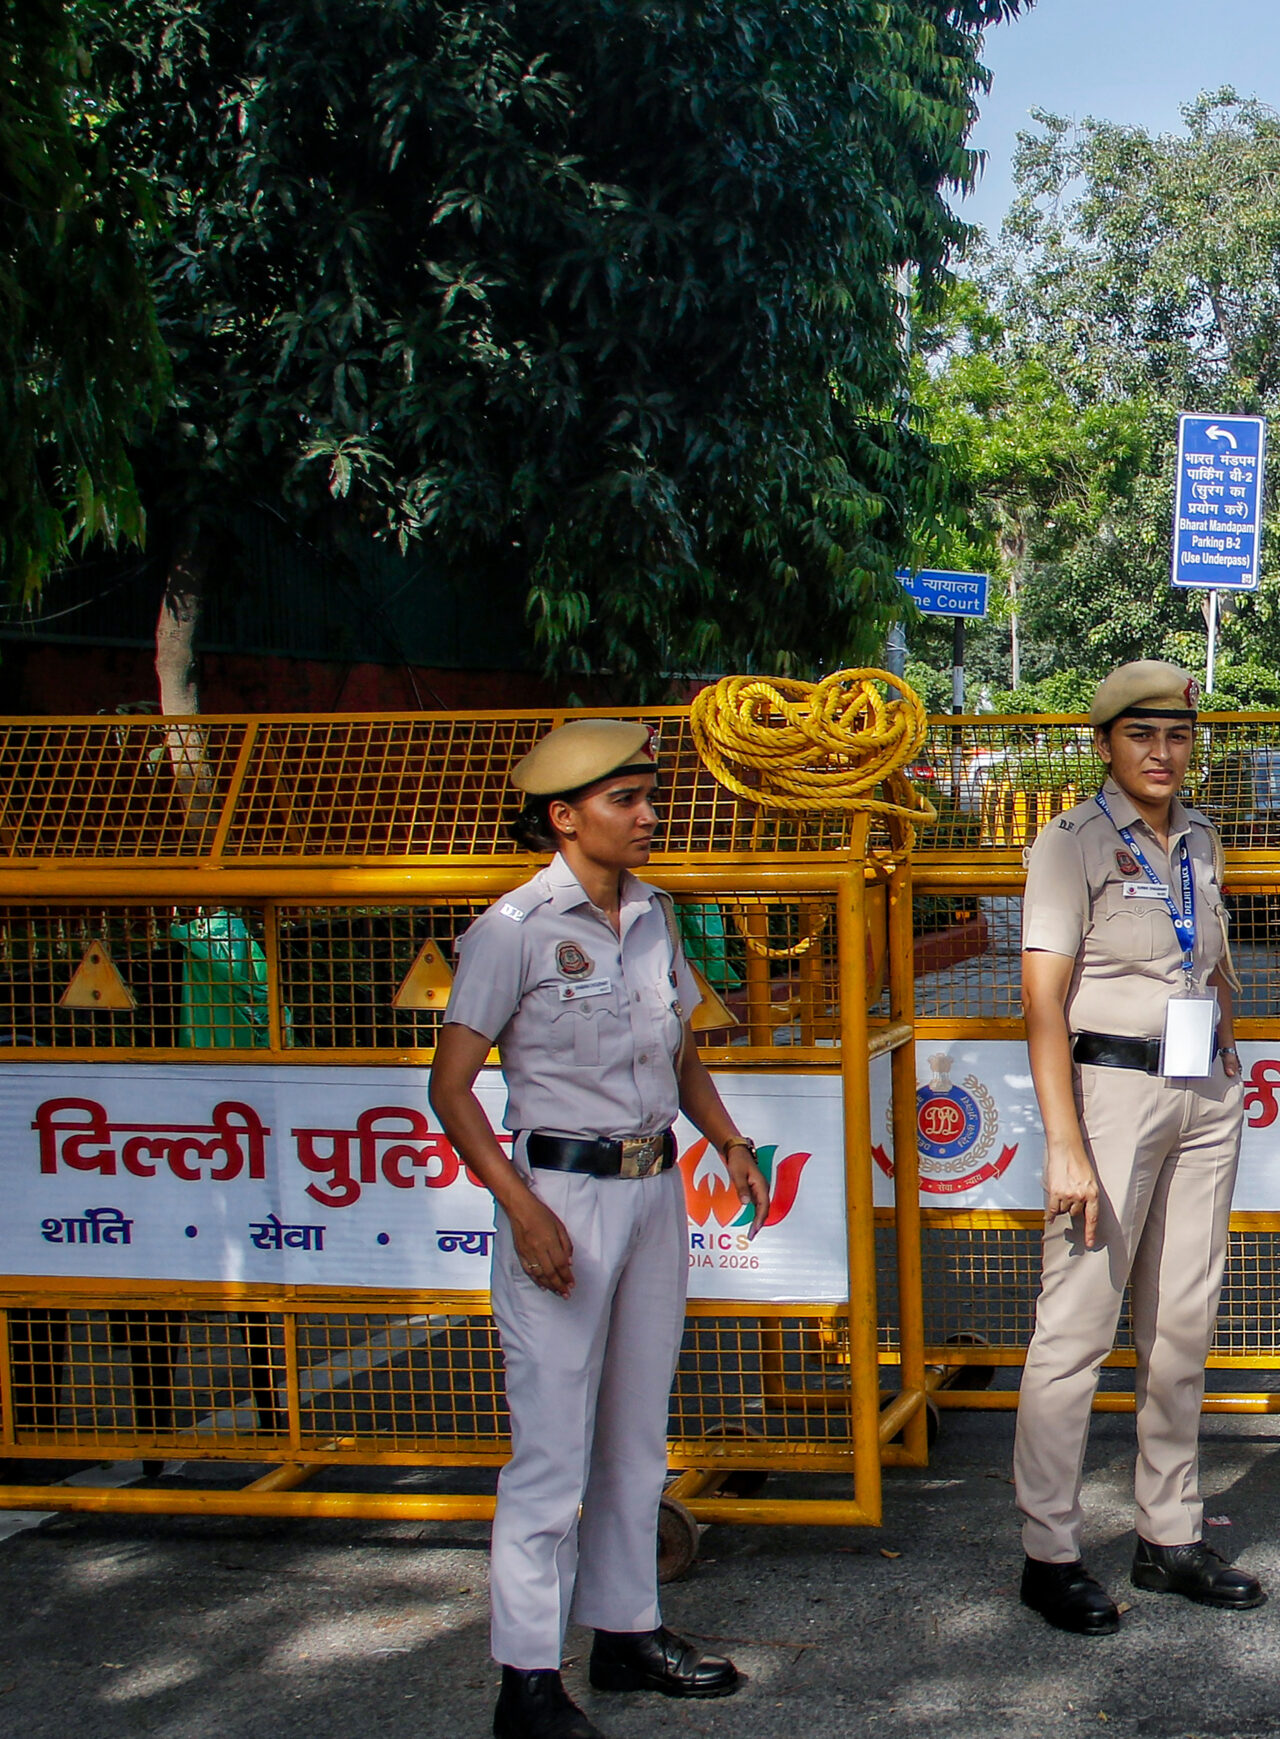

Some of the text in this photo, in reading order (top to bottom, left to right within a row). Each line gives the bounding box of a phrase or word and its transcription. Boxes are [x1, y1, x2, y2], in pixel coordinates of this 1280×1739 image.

[1184, 451, 1257, 467] भारत मंडपम
[1191, 482, 1246, 500] (सुरंग का
[1188, 500, 1220, 516] प्रयोग
[1179, 517, 1255, 535] Bharat Mandapam
[1191, 535, 1241, 551] Parking B-2
[1180, 552, 1251, 569] (Use Underpass)
[921, 578, 979, 594] न्यायालय
[937, 594, 980, 611] Court
[31, 1096, 271, 1182] दिल्ली
[40, 1206, 134, 1245] शांति
[249, 1213, 327, 1252] सेवा
[690, 1232, 750, 1251] RICS
[687, 1254, 760, 1270] DIA 2026
